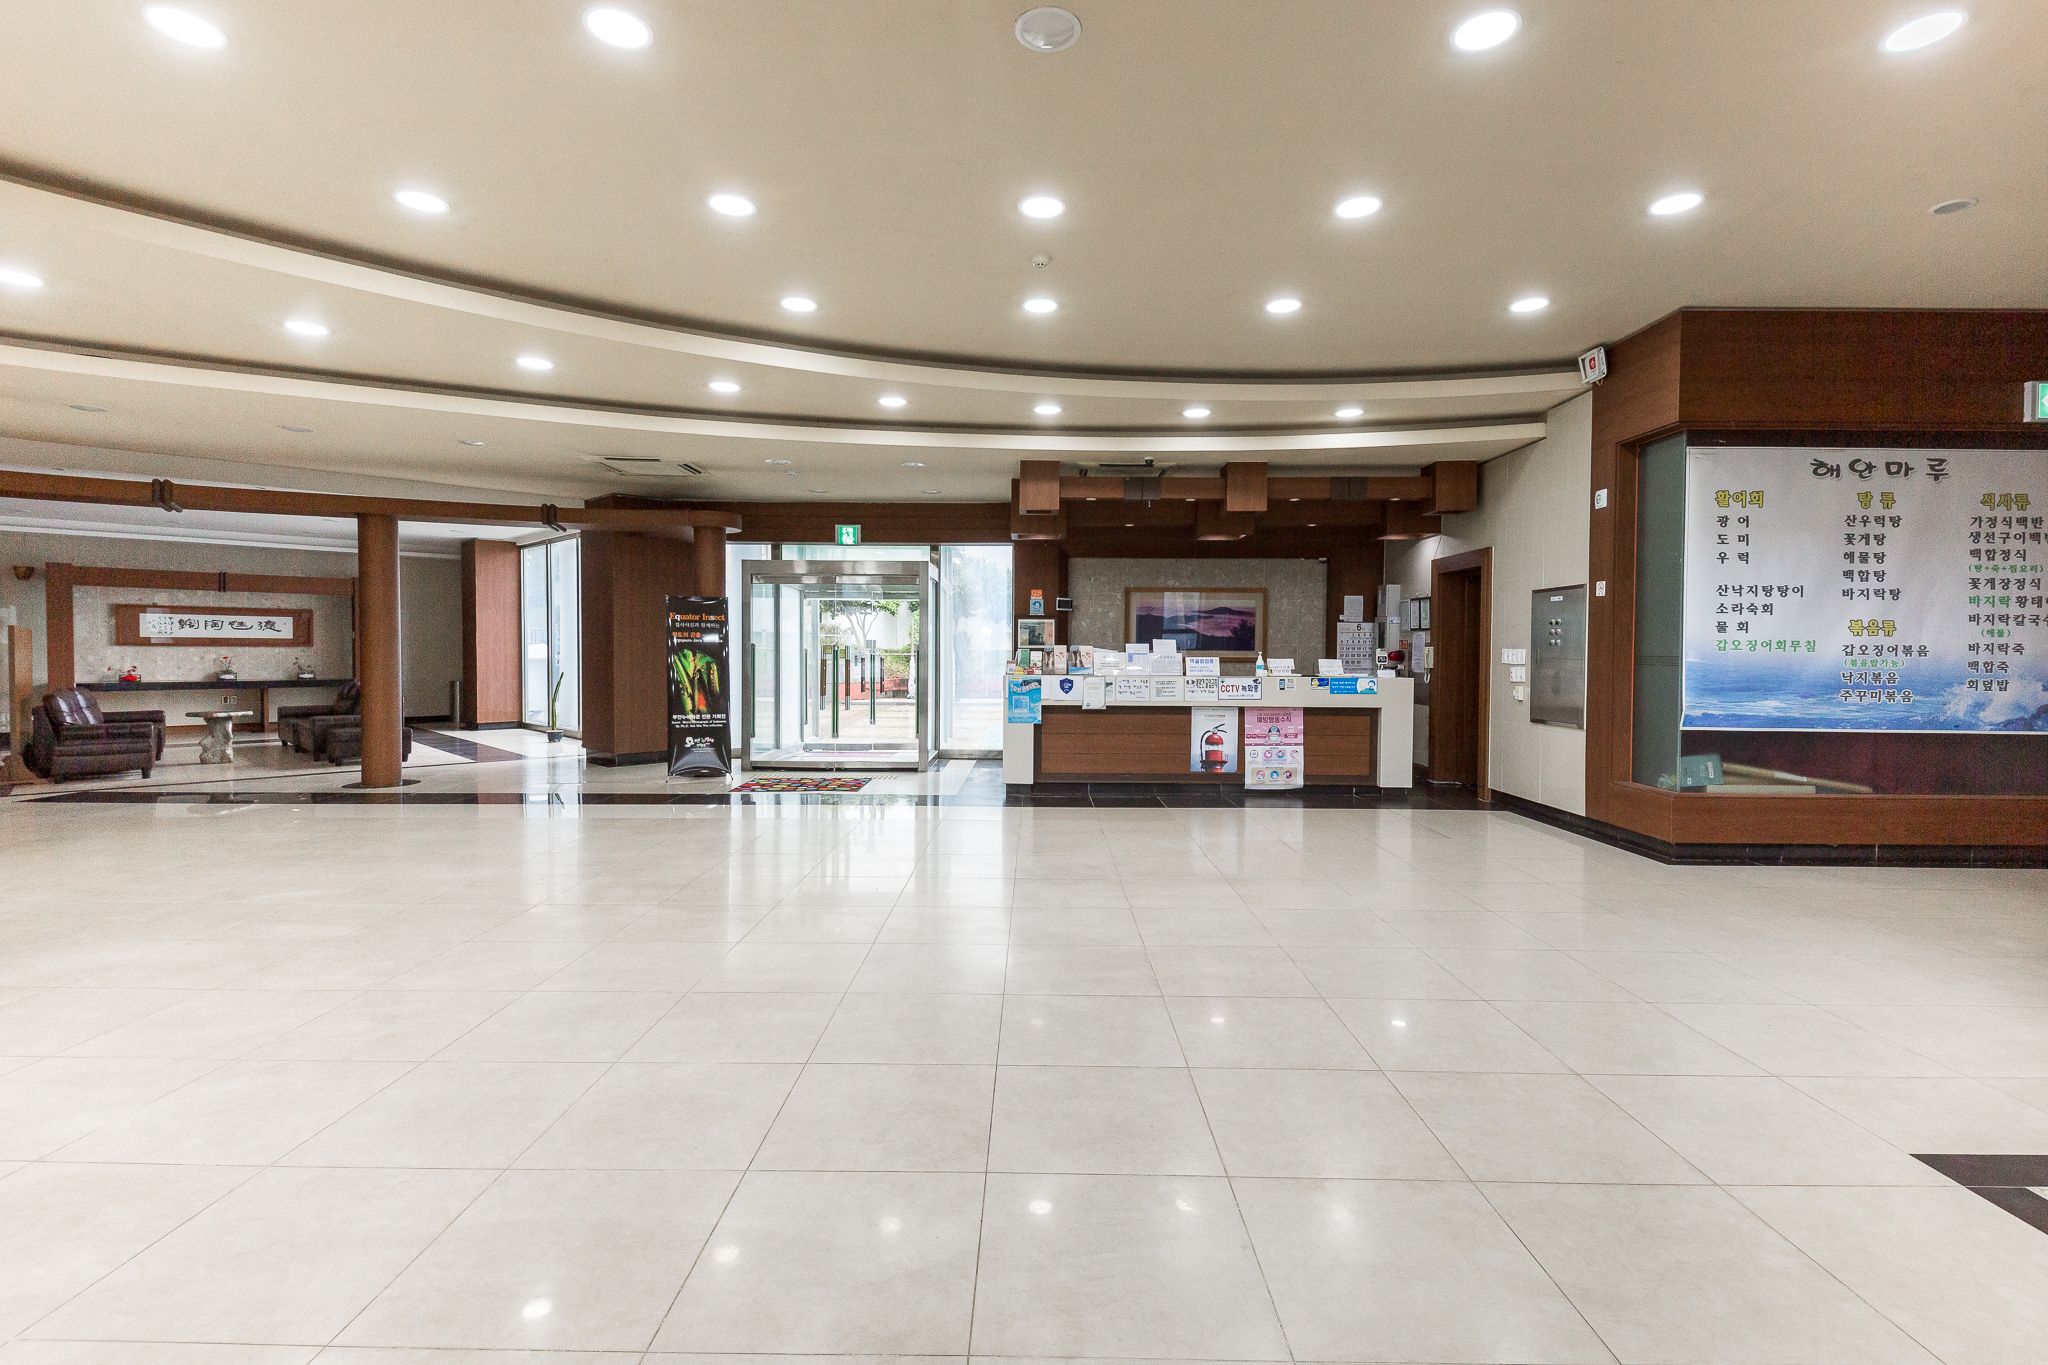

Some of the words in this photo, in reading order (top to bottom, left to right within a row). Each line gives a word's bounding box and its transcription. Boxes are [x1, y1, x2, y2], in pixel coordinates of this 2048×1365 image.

[1810, 458, 1949, 481] 해안마루
[1715, 490, 1764, 508] 활어회
[1980, 493, 2031, 511] 식사류
[1844, 515, 1902, 528] 산우럭탕
[1970, 516, 2044, 529] 가정식백반
[1844, 533, 1886, 546] 꽃게탕
[1843, 551, 1886, 564] 해물탕
[1969, 549, 2027, 561] 백합정식
[1842, 570, 1887, 582] 백합탕
[1716, 584, 1804, 597] 산낙지탕탕이
[1969, 577, 2041, 591] 꽃게장정식
[1842, 588, 1901, 601] 바지락탕
[2014, 595, 2048, 608] 황태
[1716, 603, 1774, 615] 소라숙회
[670, 612, 701, 621] Equator
[702, 613, 726, 621] Insect
[1848, 619, 1897, 637] 볶음류
[1716, 639, 1816, 652] 갑오징어회무침
[1842, 644, 1930, 657] 갑오징어볶음
[1968, 643, 2025, 655] 바지락죽
[1844, 659, 1905, 668] (볶음밥가능)
[1967, 661, 2010, 674] 백합죽
[1842, 672, 1899, 685] 낙지볶음
[1220, 684, 1240, 693] CCTV
[1241, 684, 1259, 693] 녹화중
[1967, 679, 2010, 692] 회덮밥
[1840, 690, 1914, 703] 주꾸미볶음
